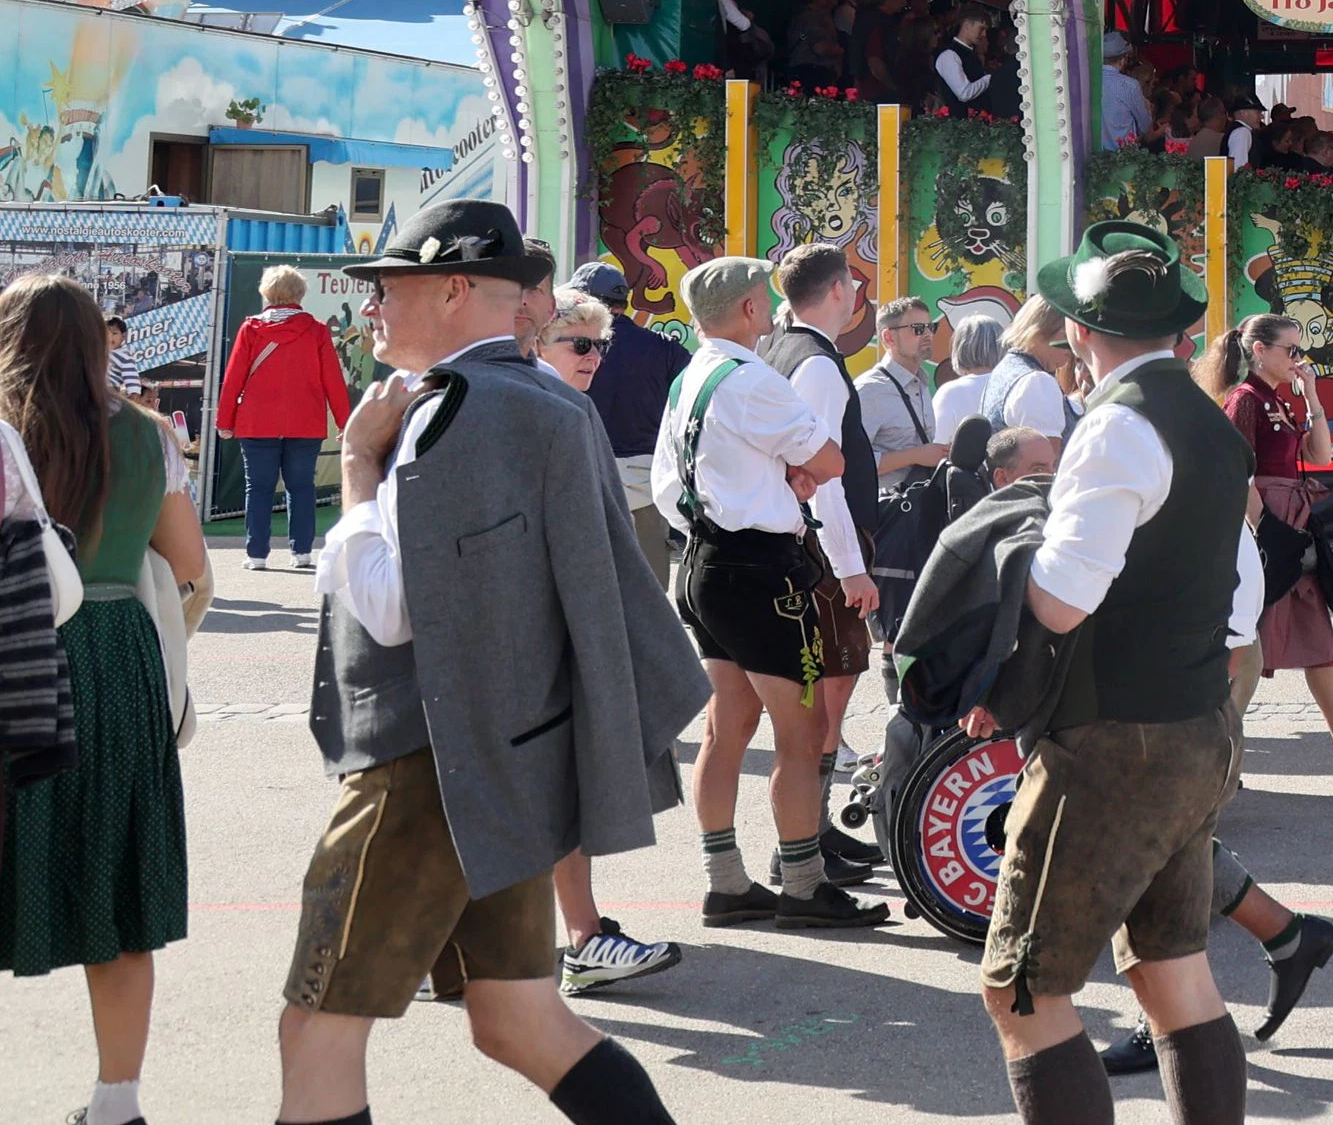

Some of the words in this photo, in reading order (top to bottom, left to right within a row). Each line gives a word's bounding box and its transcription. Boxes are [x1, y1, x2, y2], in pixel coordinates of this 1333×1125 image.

[22, 225, 186, 238] www.nostalgieautoskooter.com
[103, 281, 126, 290] 1956
[123, 317, 173, 344] hner
[132, 330, 199, 363] cooter
[928, 751, 996, 887] BAYERN
